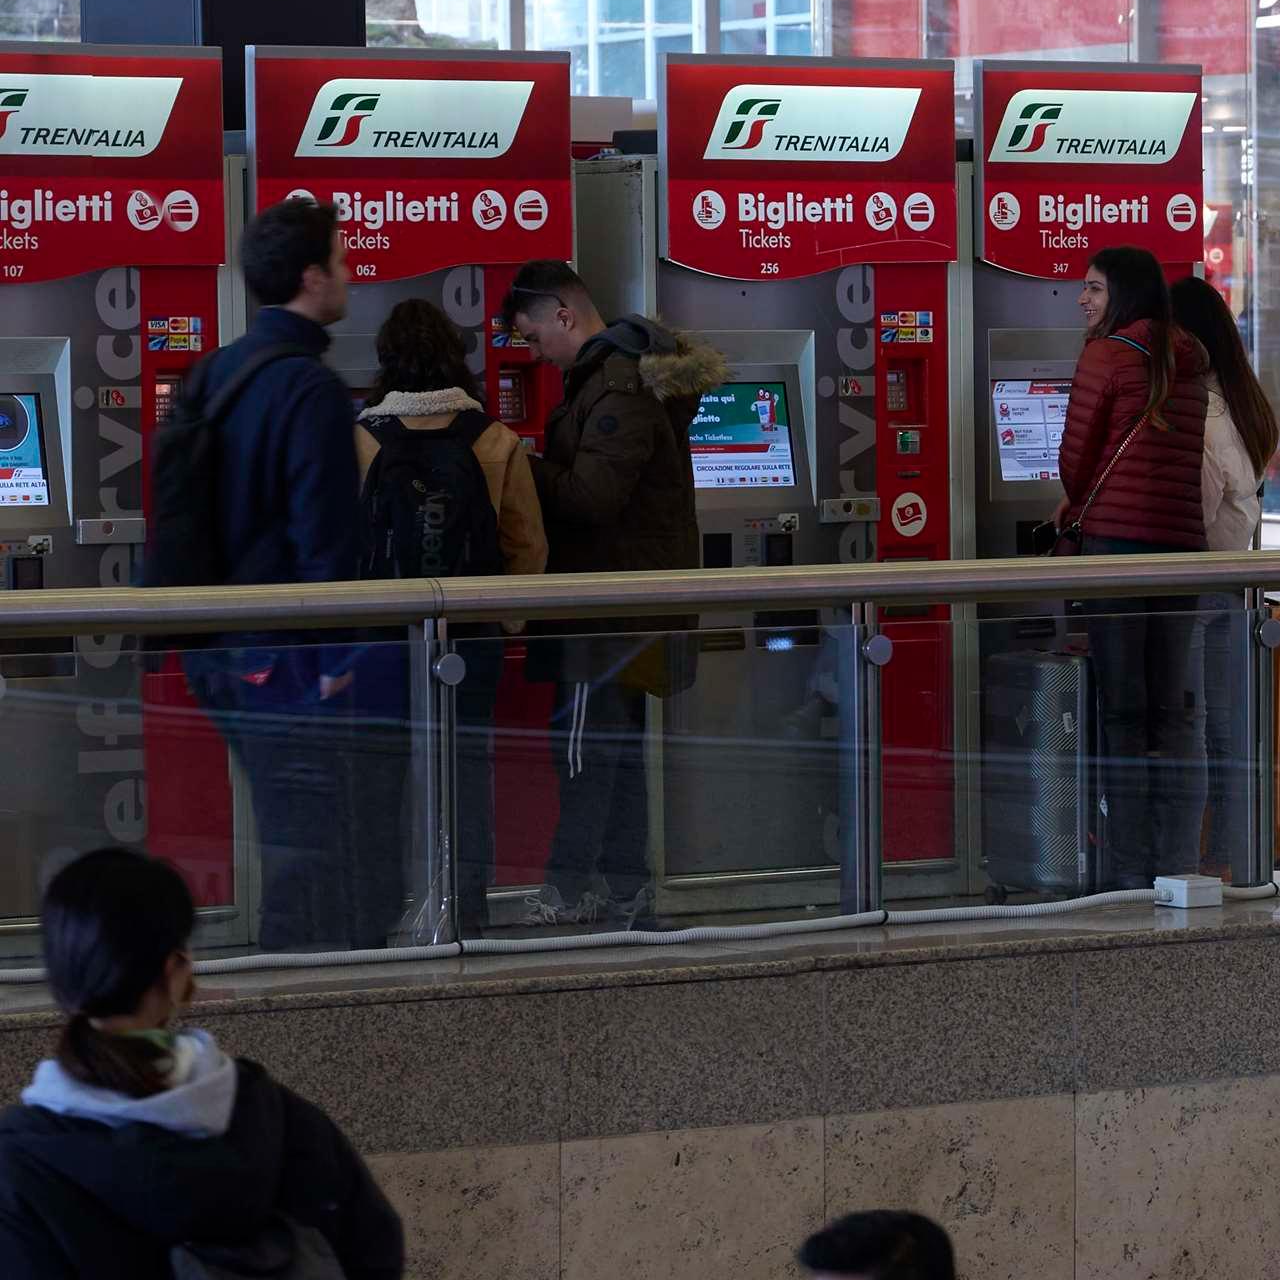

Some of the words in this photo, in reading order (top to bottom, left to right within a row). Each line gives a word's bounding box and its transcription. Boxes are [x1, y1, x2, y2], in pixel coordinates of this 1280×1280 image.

[372, 131, 499, 149] TRENITALIA
[774, 135, 890, 153] TRENITALIA
[1056, 138, 1167, 156] TRENITALIA
[332, 191, 459, 230] Biglietti
[738, 192, 853, 230] Biglietti
[1038, 194, 1149, 231] Biglietti
[739, 228, 791, 249] Tickets
[1039, 229, 1089, 249] Tickets
[3, 265, 23, 277] 107
[356, 265, 377, 276] 062
[760, 263, 779, 274] 256
[1053, 263, 1069, 273] 347
[150, 320, 166, 328] VISA
[721, 393, 735, 404] qui
[696, 464, 733, 472] CIRCOLAZIONE
[761, 463, 778, 471] SULLA
